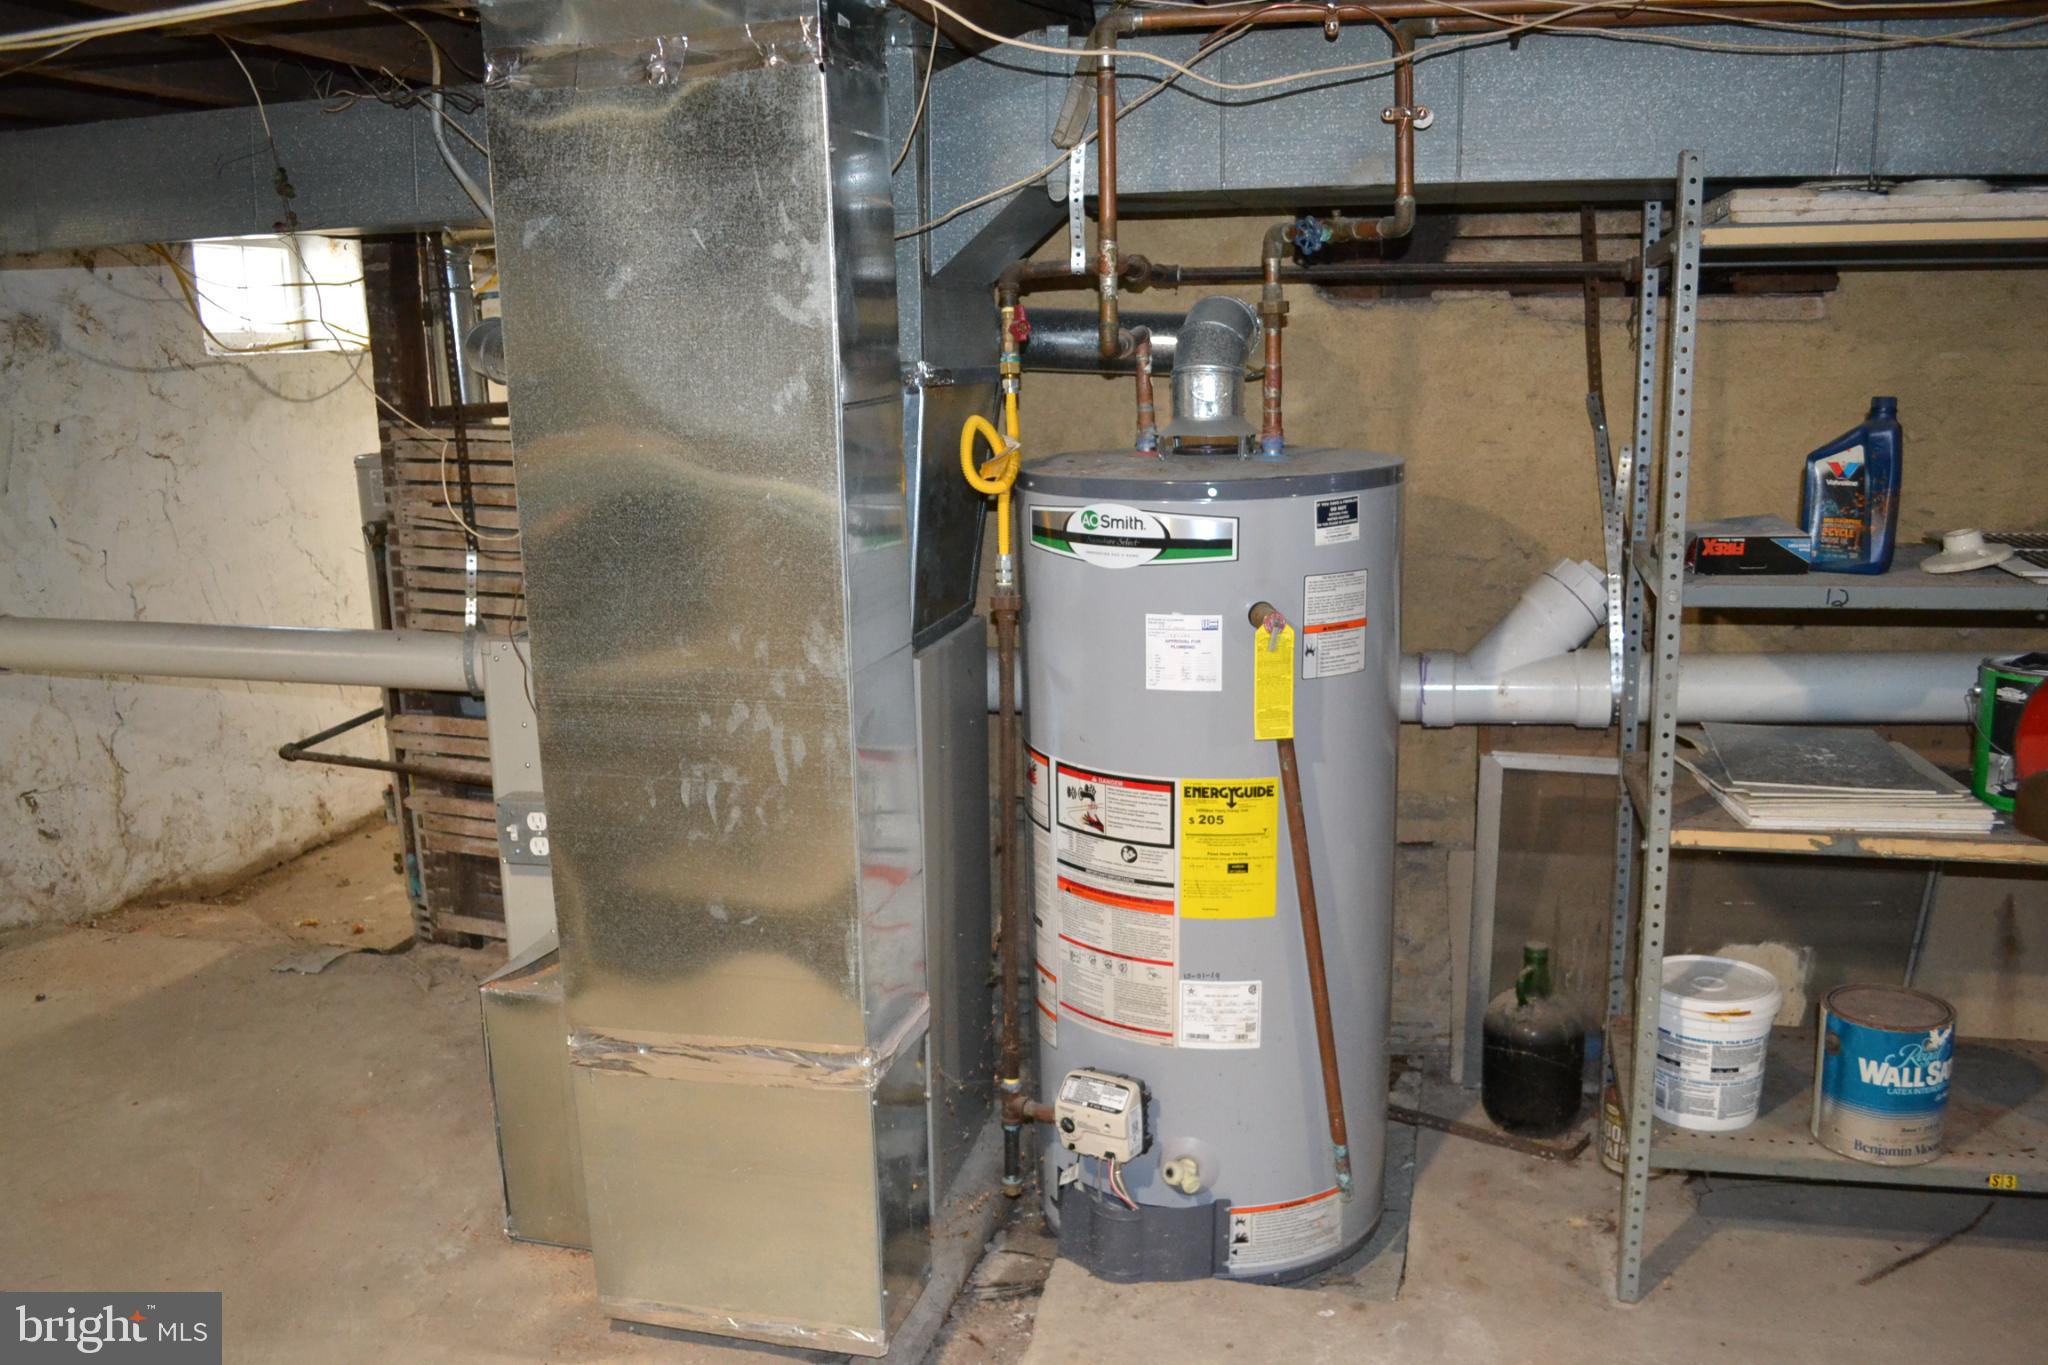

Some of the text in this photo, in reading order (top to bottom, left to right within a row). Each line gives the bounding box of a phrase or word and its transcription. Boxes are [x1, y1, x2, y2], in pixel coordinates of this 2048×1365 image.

[1702, 538, 1745, 556] FIREX
[1826, 588, 1849, 607] 12
[1183, 785, 1275, 800] ENERGYGUIDE
[1198, 814, 1224, 825] 205
[1858, 1057, 1925, 1088] WALL
[1886, 1087, 1913, 1096] LATEX
[1854, 1139, 1912, 1157] Benjamin
